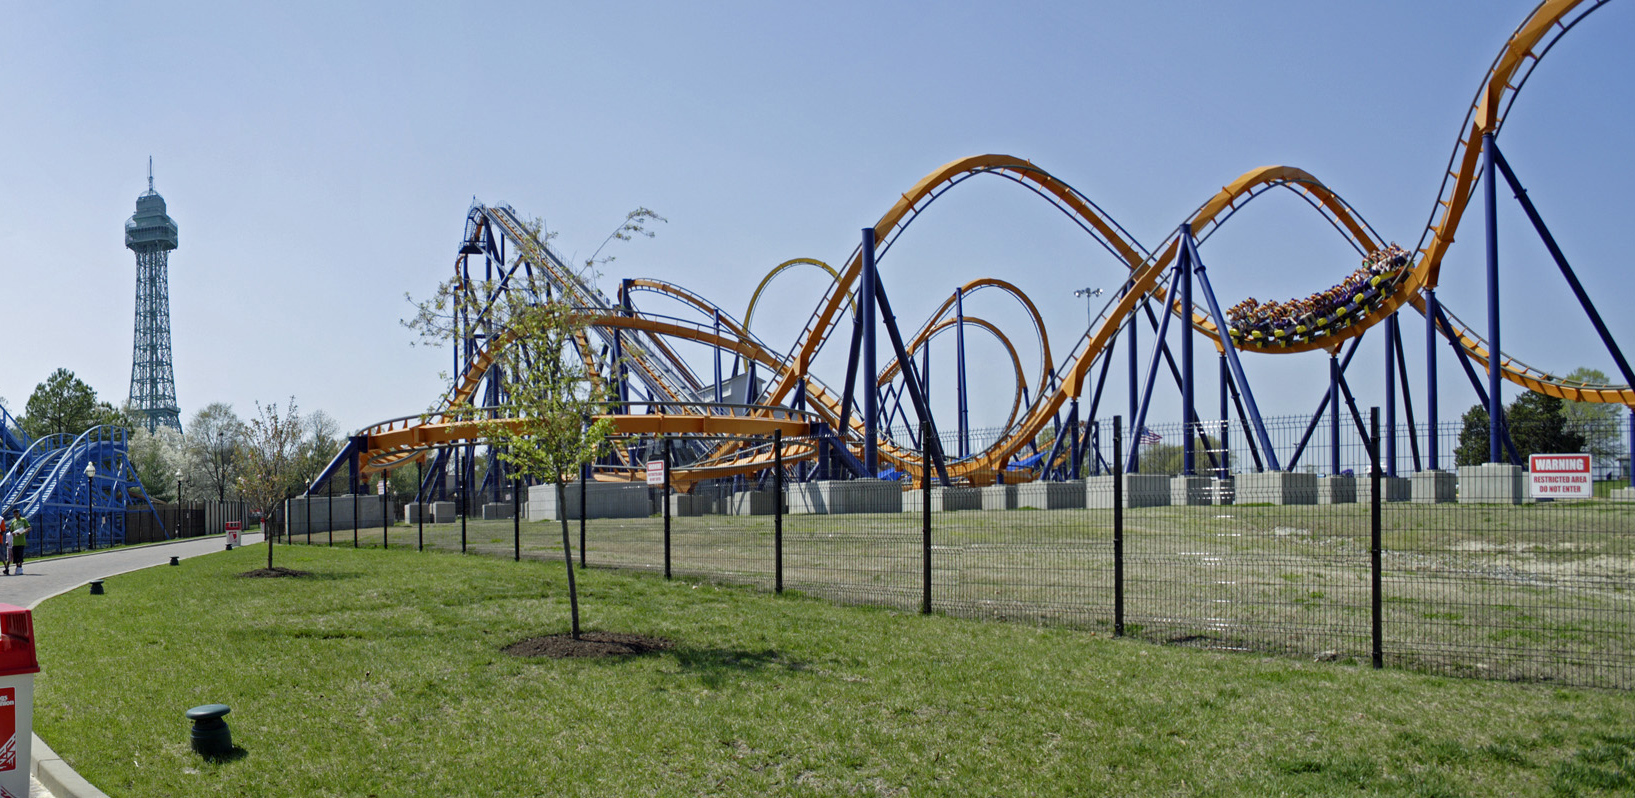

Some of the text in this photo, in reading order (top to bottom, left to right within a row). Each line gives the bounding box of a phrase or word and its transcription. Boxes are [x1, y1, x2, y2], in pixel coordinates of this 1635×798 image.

[1535, 458, 1584, 471] WARNING
[1539, 485, 1581, 493] DO NOT ENTER
